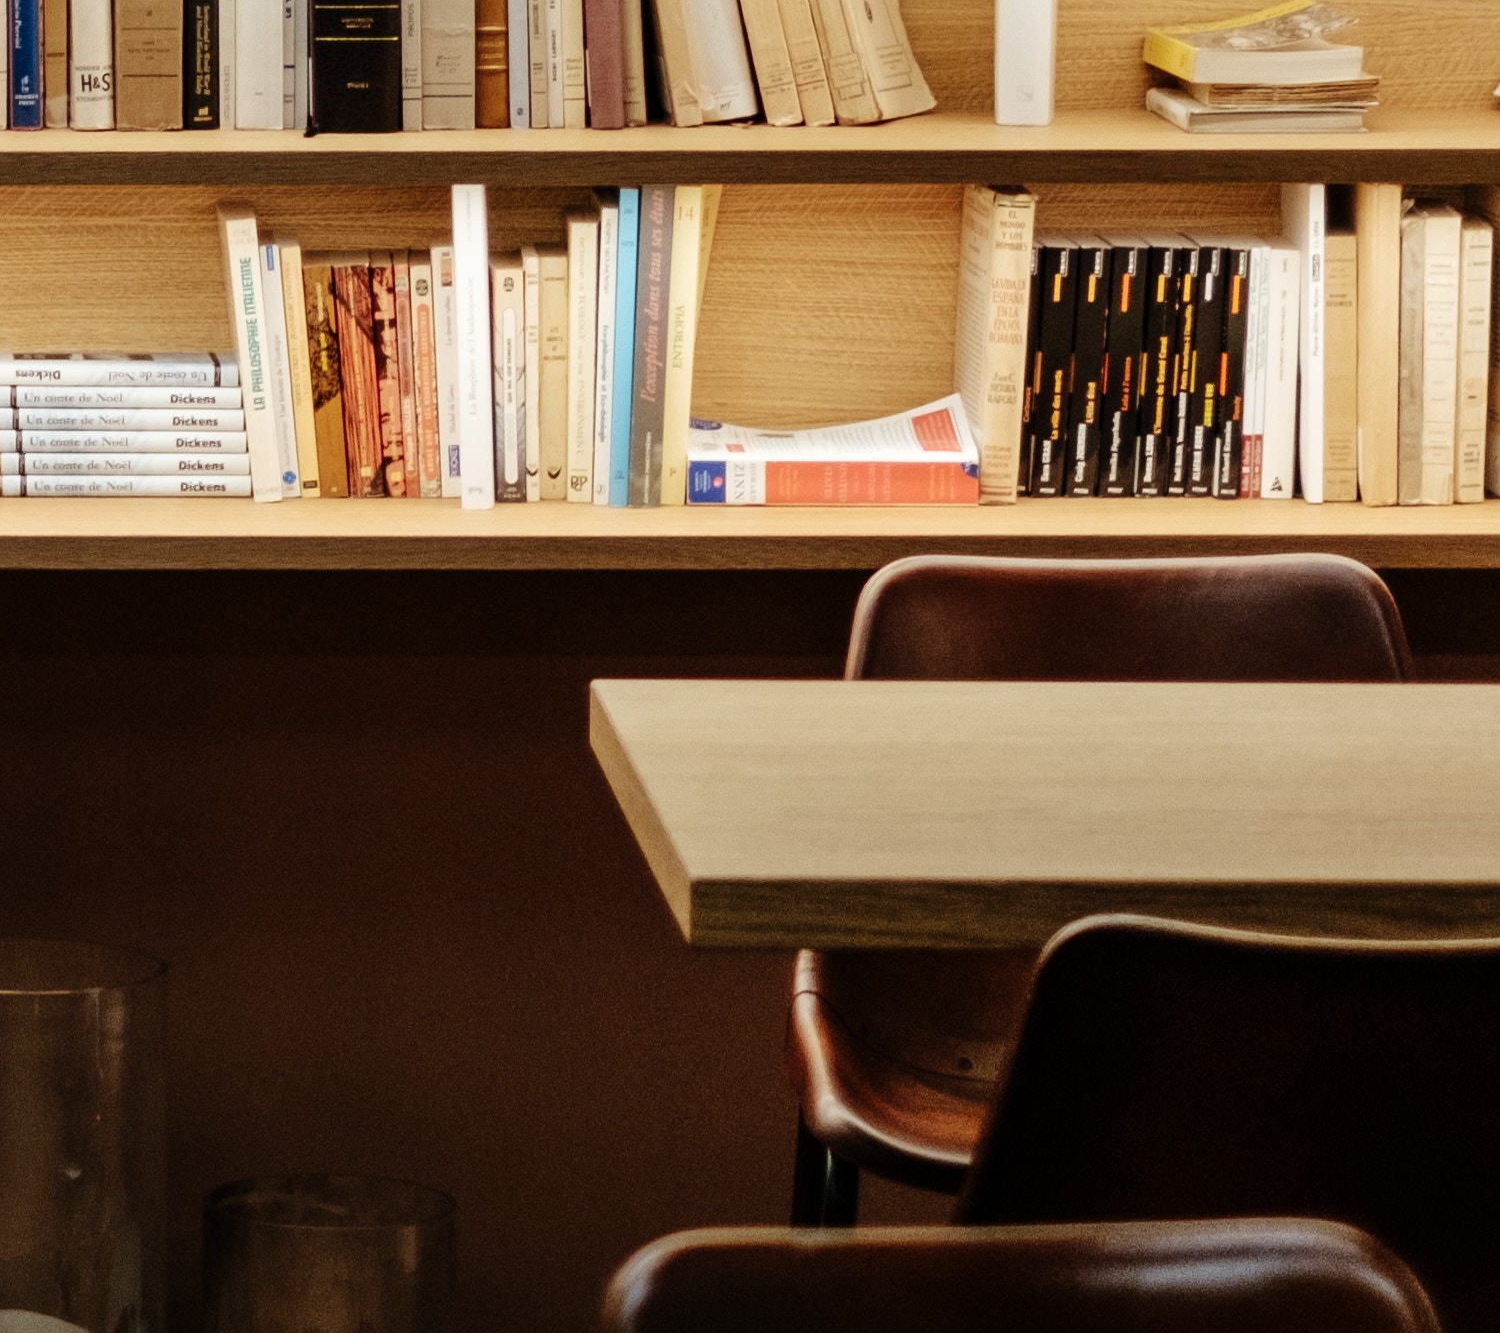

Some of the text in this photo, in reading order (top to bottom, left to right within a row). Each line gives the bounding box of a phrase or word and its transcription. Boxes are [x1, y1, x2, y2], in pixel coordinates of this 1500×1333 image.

[81, 73, 110, 92] H&S
[241, 257, 265, 411] LA PHILOSOPHIE ITALIENNE
[671, 304, 685, 369] ENTROPIA
[24, 393, 40, 402] Un
[79, 393, 92, 402] de
[170, 394, 216, 404] Dickens
[735, 464, 745, 500] ZINN
